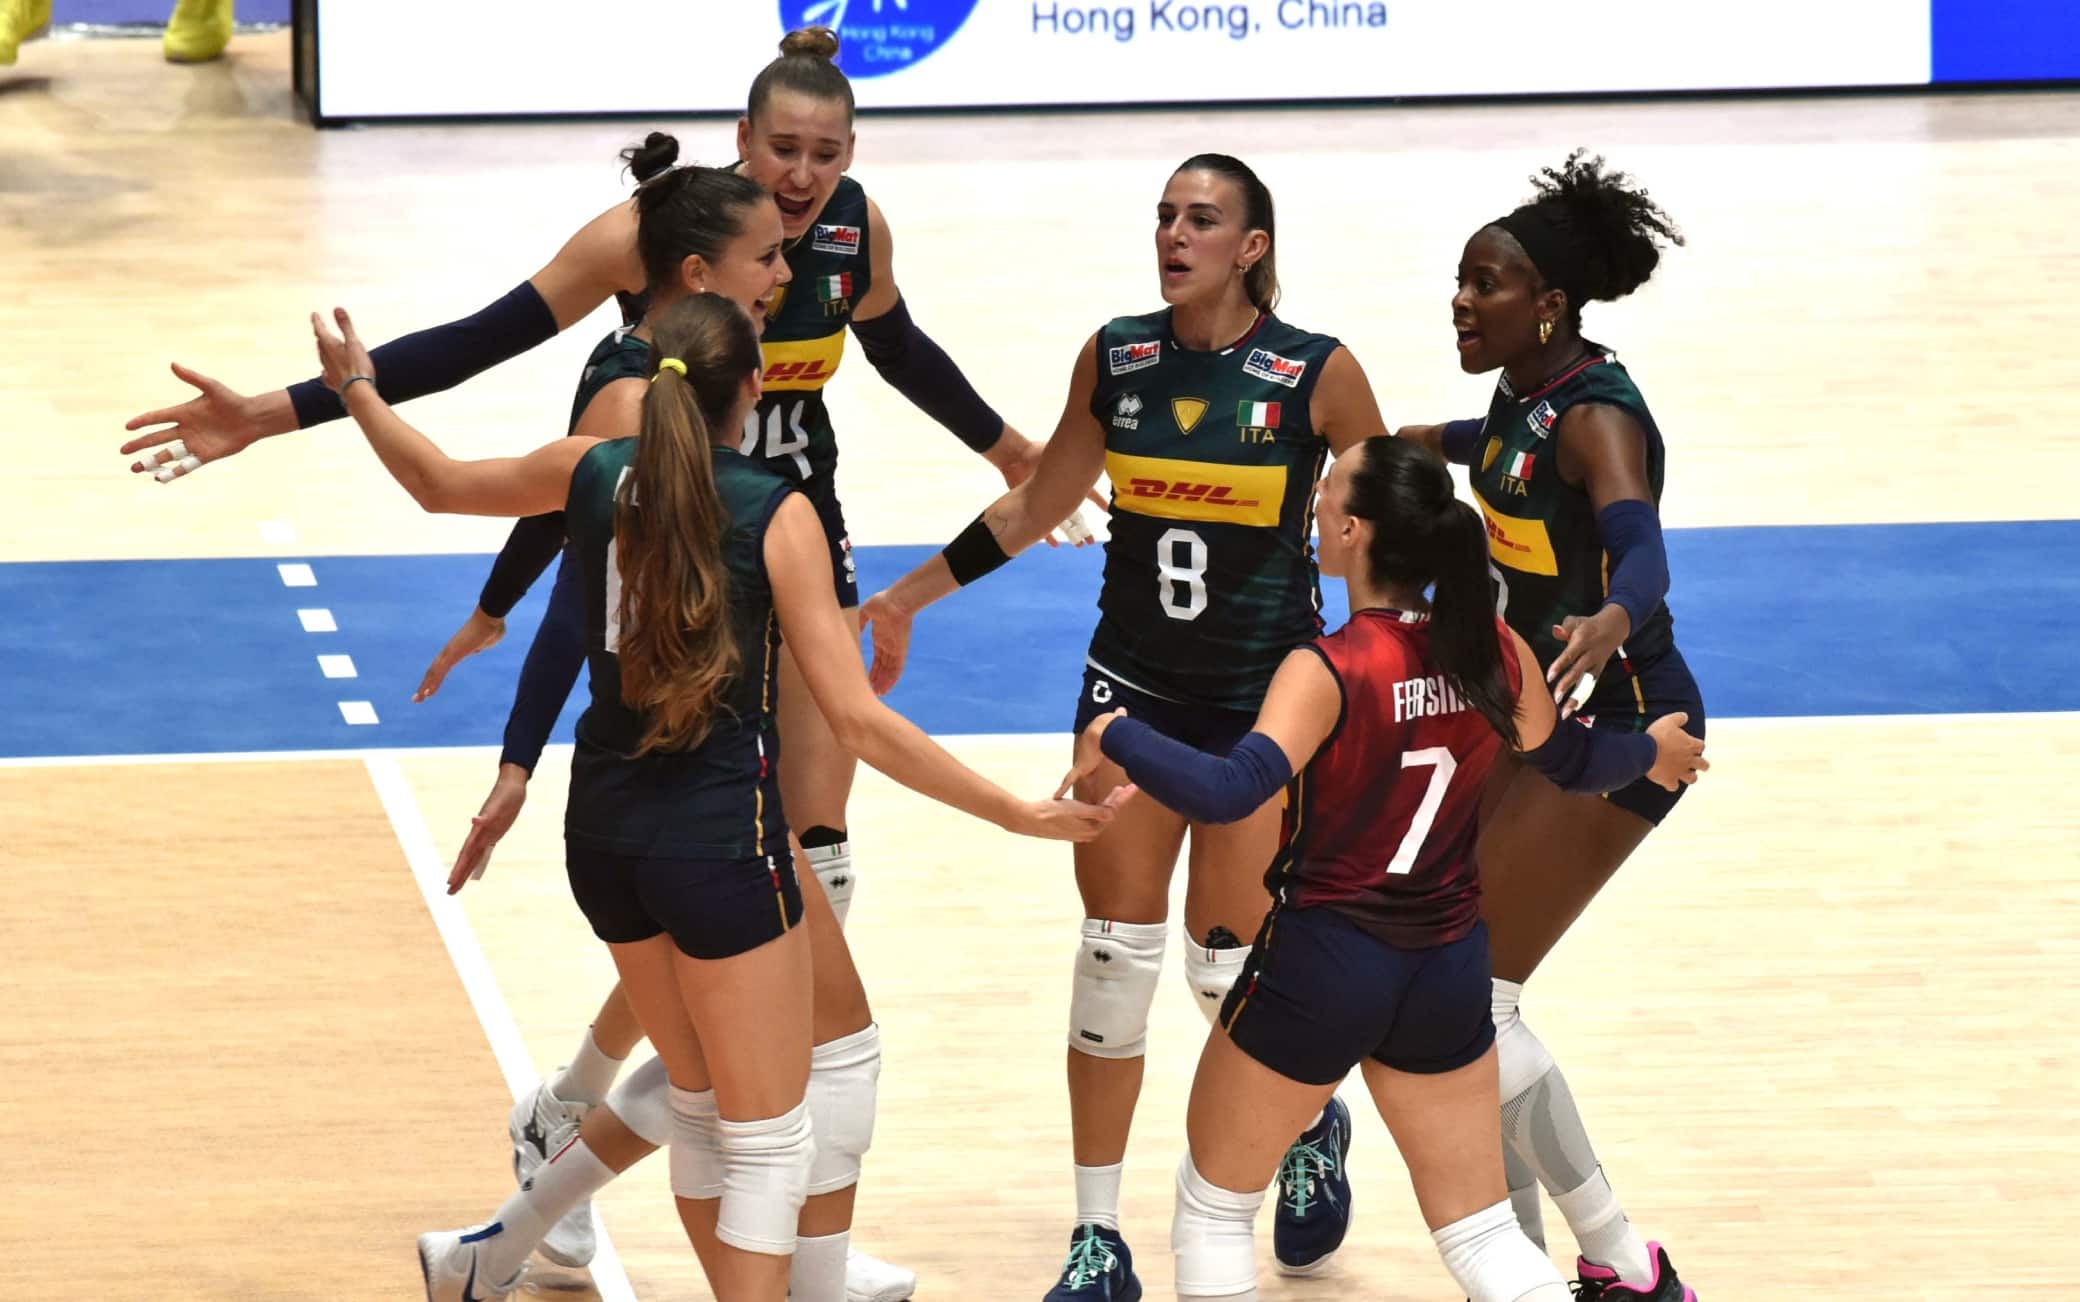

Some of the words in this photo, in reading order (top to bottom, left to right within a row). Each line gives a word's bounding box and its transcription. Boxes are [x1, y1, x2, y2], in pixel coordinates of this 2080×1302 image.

[1032, 1, 1134, 42] Hong
[1151, 0, 1260, 40] Kong,
[1277, 0, 1388, 29] China
[823, 301, 850, 317] ITA
[1111, 343, 1159, 364] BigMat
[1249, 350, 1304, 376] BigMat
[762, 359, 830, 381] HL
[1239, 427, 1276, 444] ITA
[1127, 477, 1240, 507] DHL
[1500, 473, 1527, 496] ITA
[1157, 528, 1208, 621] 8
[1392, 675, 1475, 722] FERSI
[1386, 746, 1457, 874] 7
